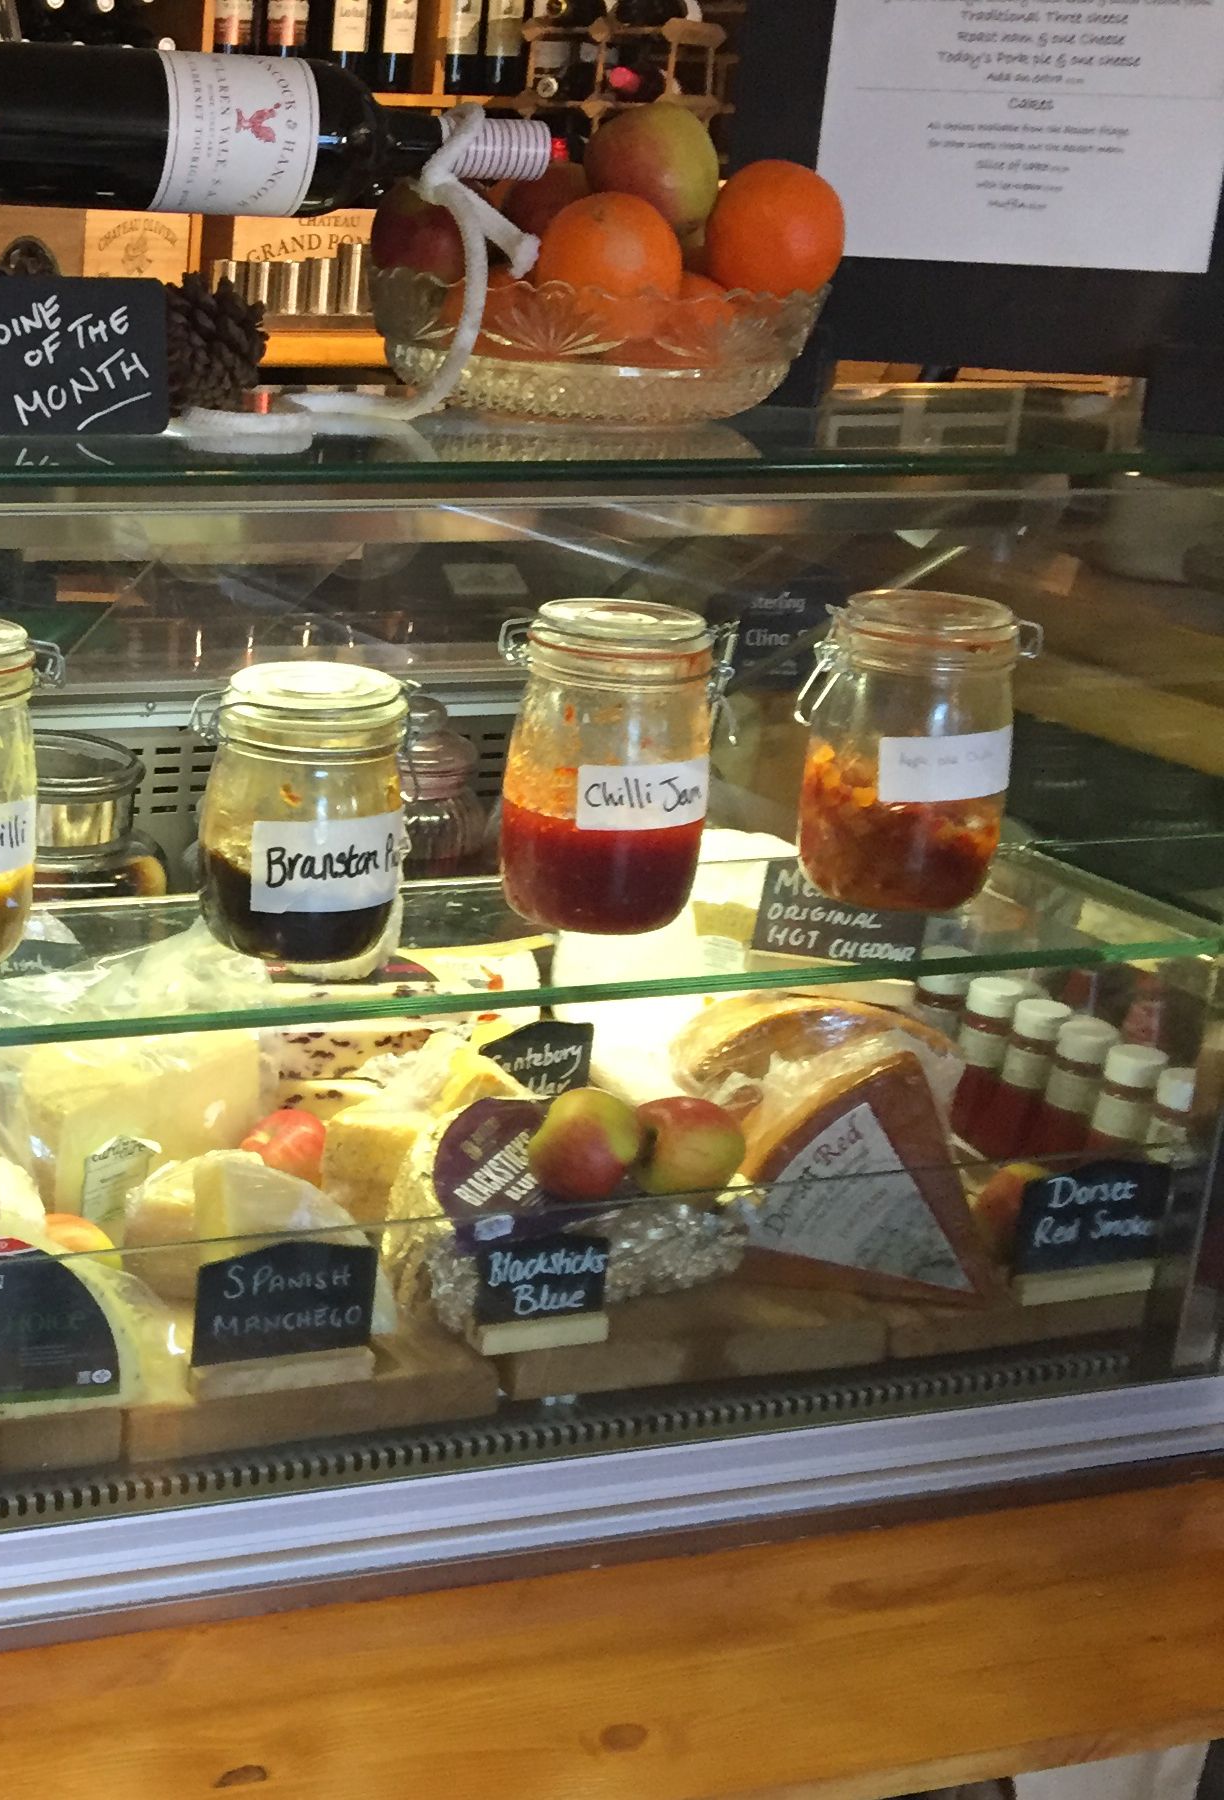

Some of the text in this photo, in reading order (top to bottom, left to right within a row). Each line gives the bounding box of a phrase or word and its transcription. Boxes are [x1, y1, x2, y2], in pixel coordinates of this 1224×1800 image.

[246, 233, 322, 262] GRAND
[24, 306, 130, 367] OF THE
[14, 348, 150, 426] MONTH
[584, 776, 653, 809] Chilli
[266, 844, 380, 889] Branston
[767, 902, 882, 929] ORIGINAL
[828, 938, 916, 962] CHEDDAR
[813, 1113, 864, 1167] Red
[1047, 1176, 1139, 1208] Dorset
[1033, 1216, 1081, 1248] Red
[223, 1264, 352, 1299] SPANISH
[488, 1245, 609, 1287] Blacksticks
[512, 1284, 586, 1315] Blue
[212, 1305, 363, 1337] MANCHEGO
